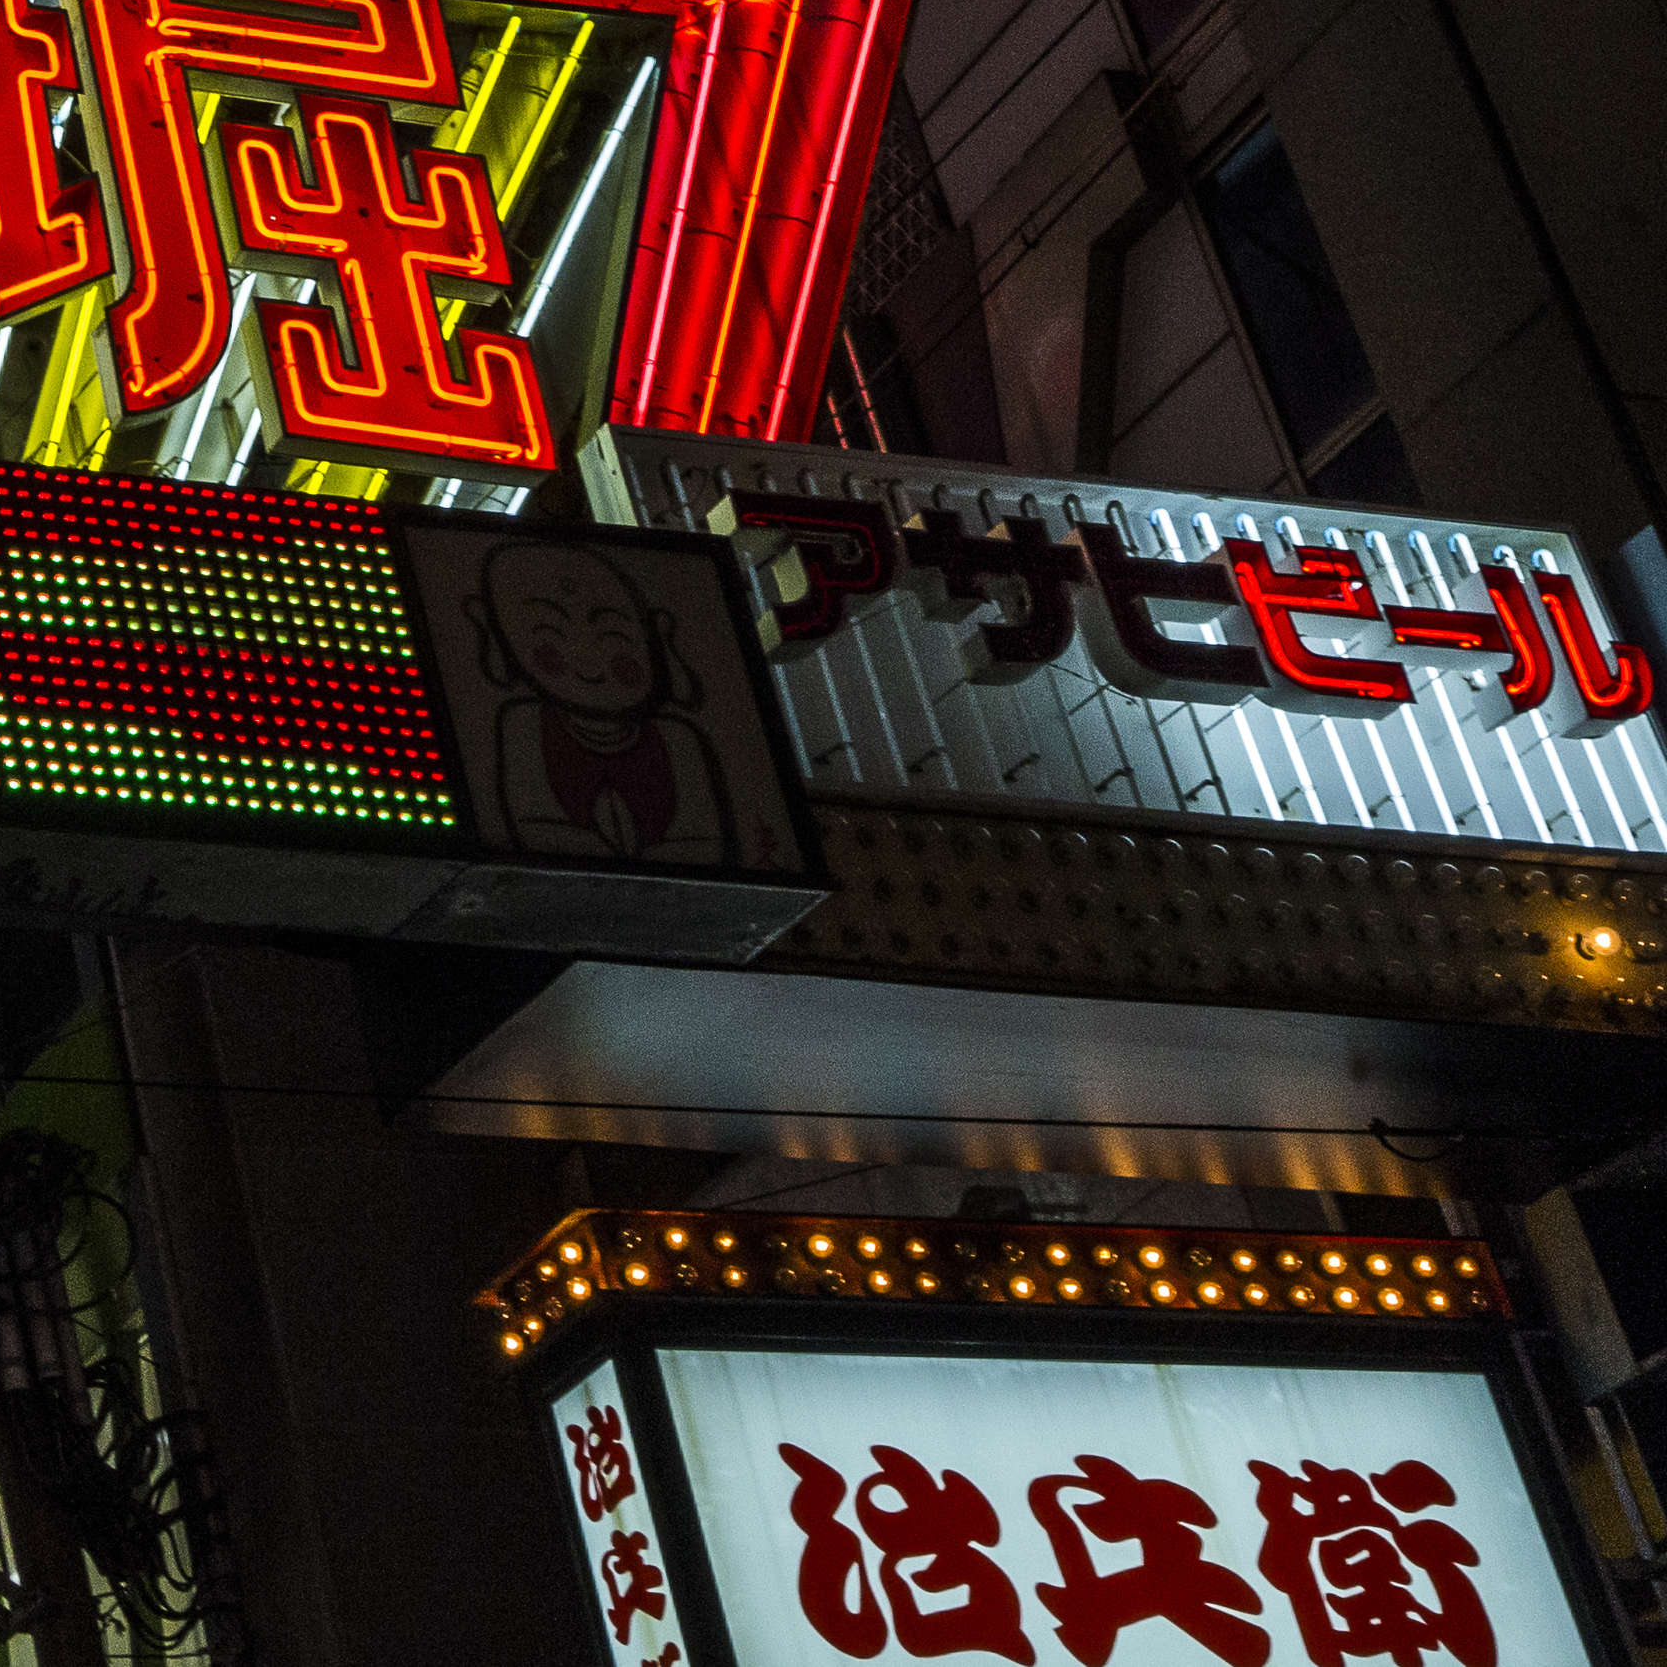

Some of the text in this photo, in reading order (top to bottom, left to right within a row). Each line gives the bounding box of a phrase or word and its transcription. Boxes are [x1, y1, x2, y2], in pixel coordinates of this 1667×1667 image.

[717, 486, 1654, 722] アサヒビール
[566, 1405, 680, 1667] 治兵
[778, 1442, 1498, 1667] 治兵衛
